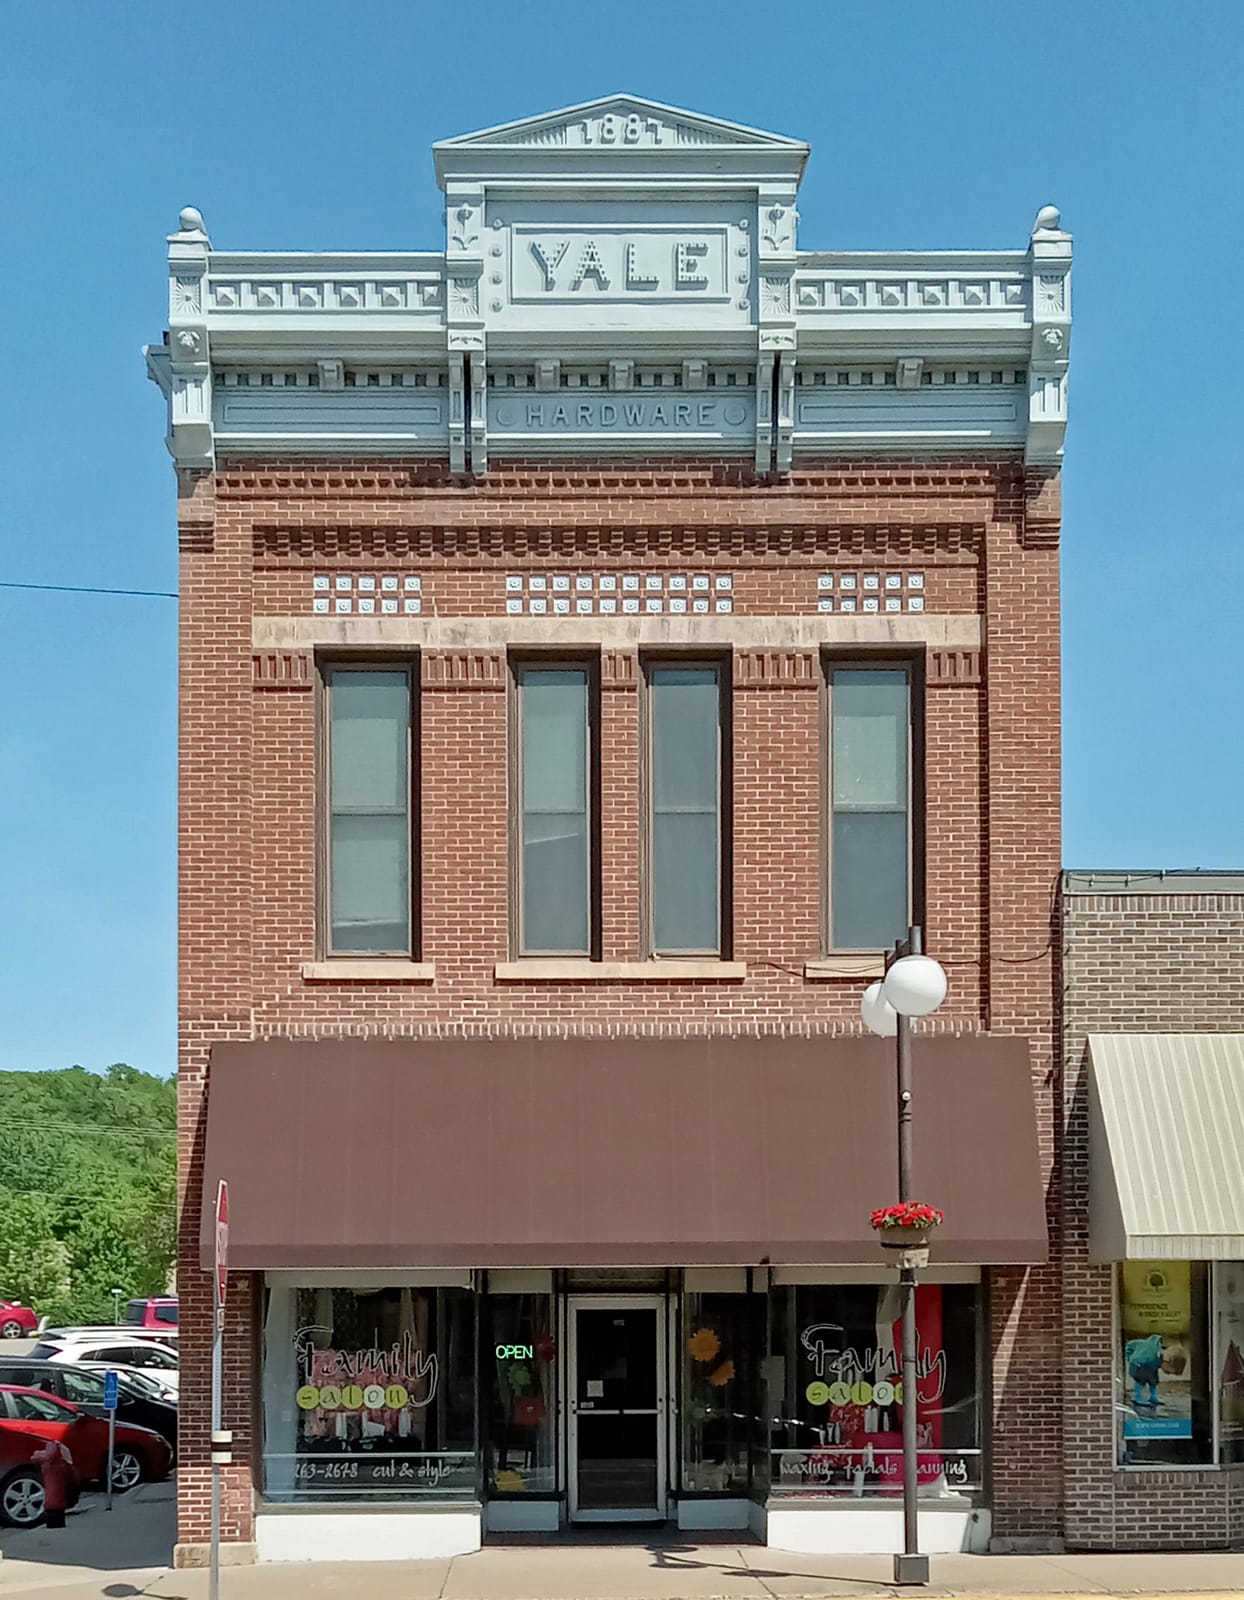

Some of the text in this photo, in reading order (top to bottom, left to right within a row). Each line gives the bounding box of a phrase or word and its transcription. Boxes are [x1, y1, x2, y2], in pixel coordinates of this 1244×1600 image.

[581, 113, 663, 143] 1887
[528, 240, 709, 291] YALE
[526, 403, 716, 427] HARDWARE
[495, 1344, 533, 1359] OPEN
[801, 1323, 947, 1403] Famy
[291, 1325, 438, 1407] Family
[808, 1383, 903, 1404] salo
[372, 1459, 395, 1478] cut
[399, 1462, 414, 1478] &
[417, 1459, 451, 1486] style
[781, 1459, 834, 1484] waxing
[915, 1459, 968, 1483] anning
